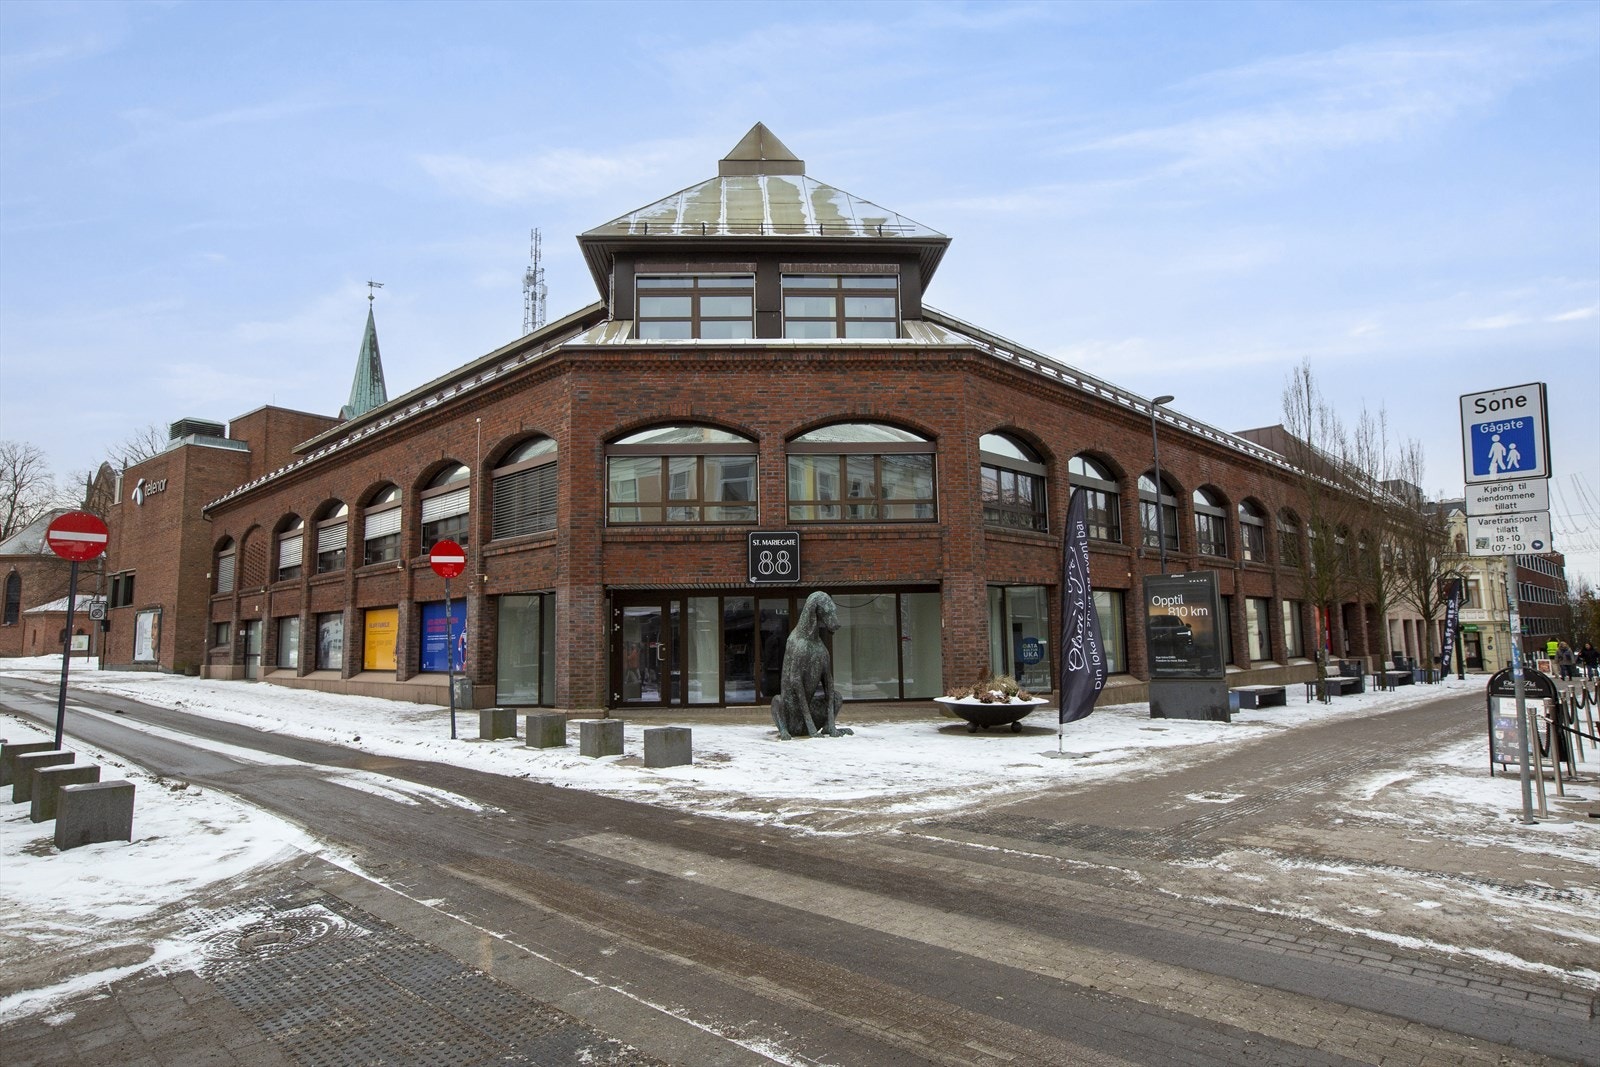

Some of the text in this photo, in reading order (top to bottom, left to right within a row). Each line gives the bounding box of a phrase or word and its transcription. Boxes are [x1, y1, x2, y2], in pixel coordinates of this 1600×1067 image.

[1474, 395, 1527, 414] Sone
[1480, 420, 1523, 433] Gågate
[1483, 482, 1527, 494] Kjøring til
[1477, 493, 1535, 502] eiendommene
[1495, 502, 1518, 510] tillatt
[1478, 515, 1538, 526] Varetransport
[758, 550, 792, 575] 88
[1152, 594, 1184, 608] Opptil
[1168, 606, 1208, 617] 810 km
[1086, 630, 1101, 666] lokale
